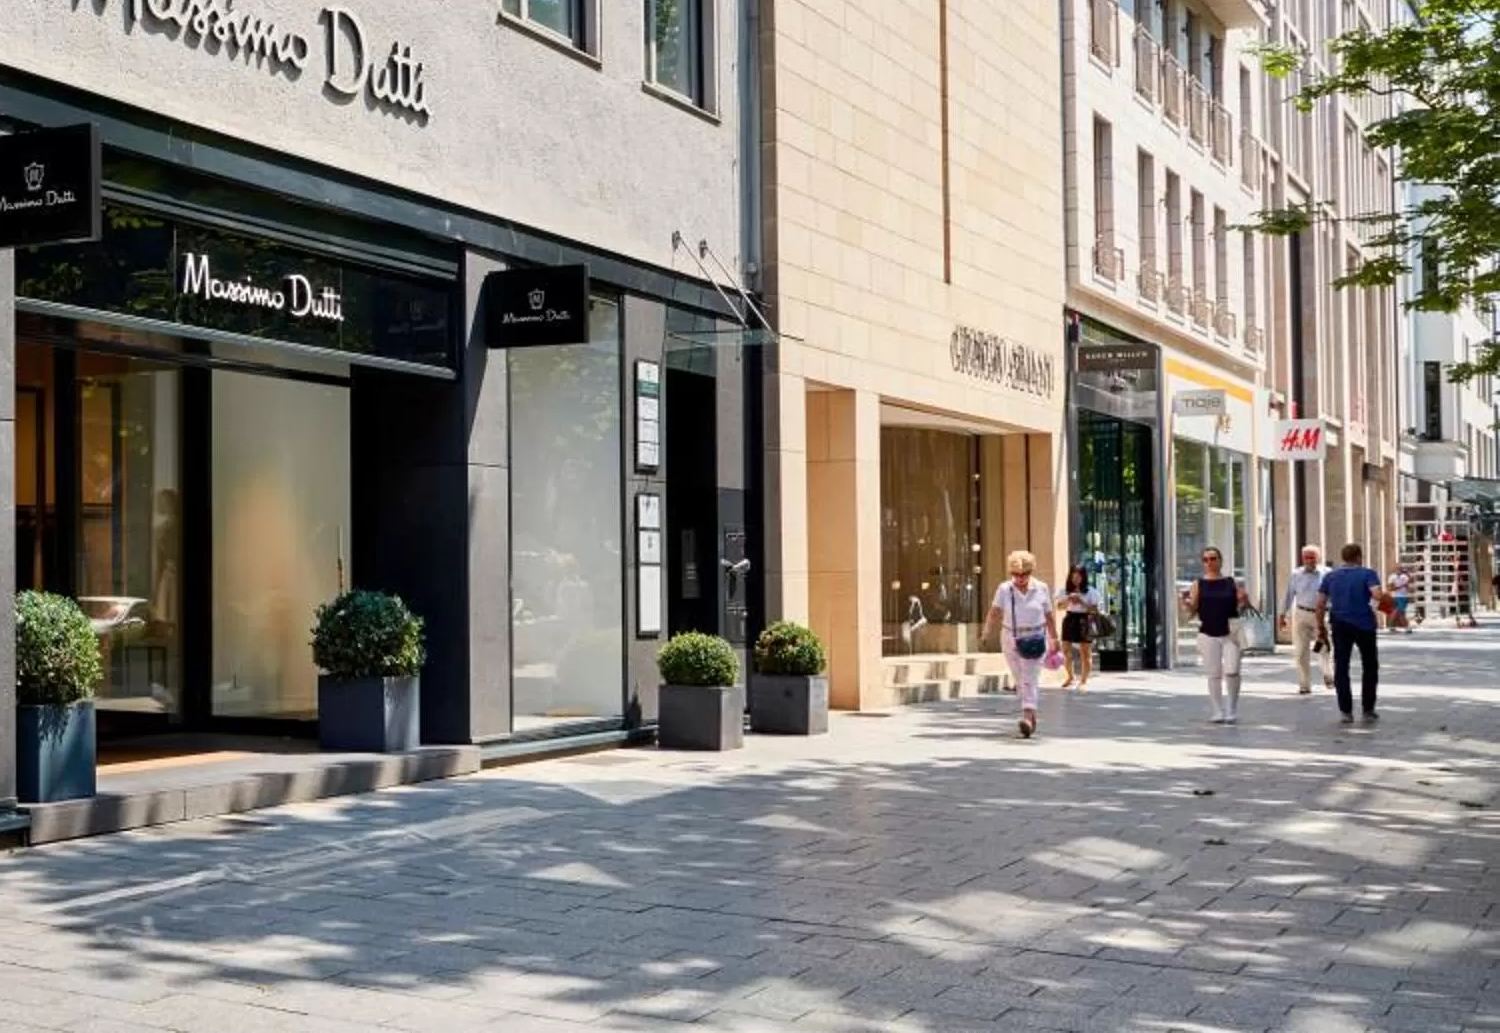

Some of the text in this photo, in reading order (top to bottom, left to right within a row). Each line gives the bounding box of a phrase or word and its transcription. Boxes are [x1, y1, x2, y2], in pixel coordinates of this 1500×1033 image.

[318, 7, 433, 125] Dutti
[45, 190, 77, 206] Dutti
[182, 251, 345, 321] Massimo Dutti
[1281, 427, 1321, 452] H&M
